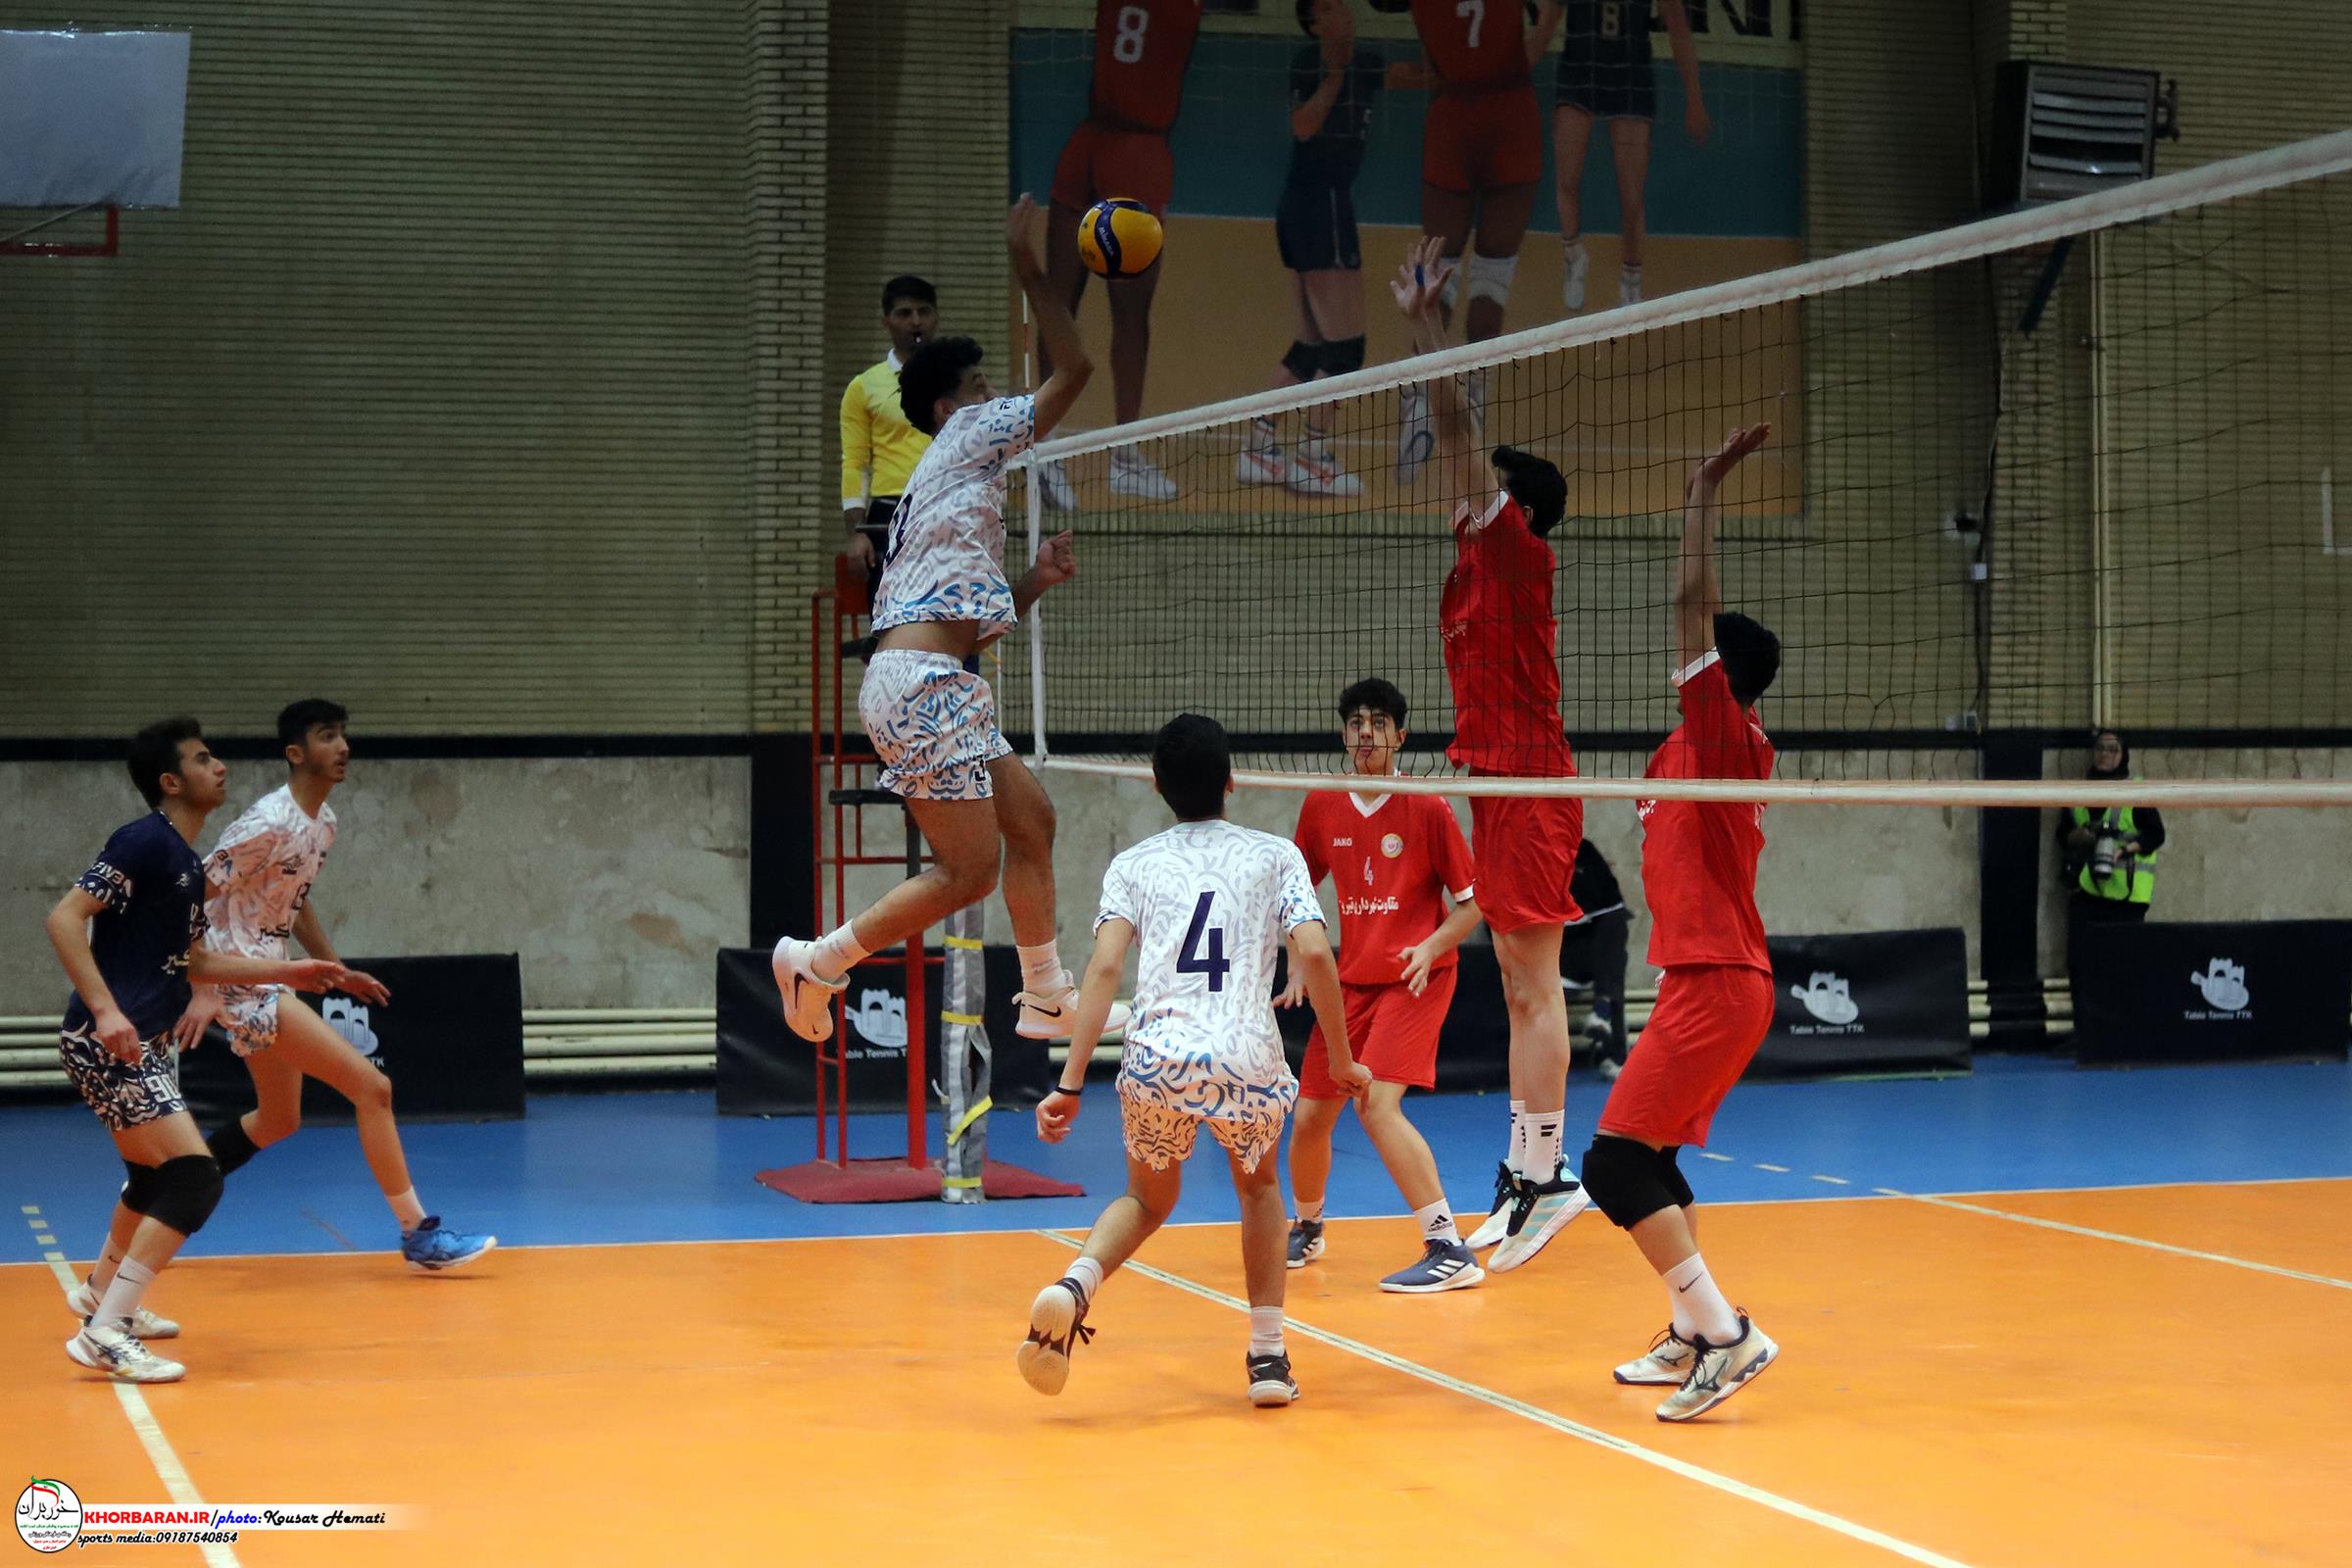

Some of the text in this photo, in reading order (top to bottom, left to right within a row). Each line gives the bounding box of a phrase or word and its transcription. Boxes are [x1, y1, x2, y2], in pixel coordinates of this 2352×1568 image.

[1113, 5, 1149, 63] 8
[1456, 0, 1486, 48] 7
[1333, 837, 1353, 847] JAKO
[1363, 856, 1374, 886] 4
[1176, 891, 1230, 992] 4
[1789, 1025, 1814, 1035] Table
[846, 1049, 863, 1058] able
[865, 1048, 899, 1058] Tennis
